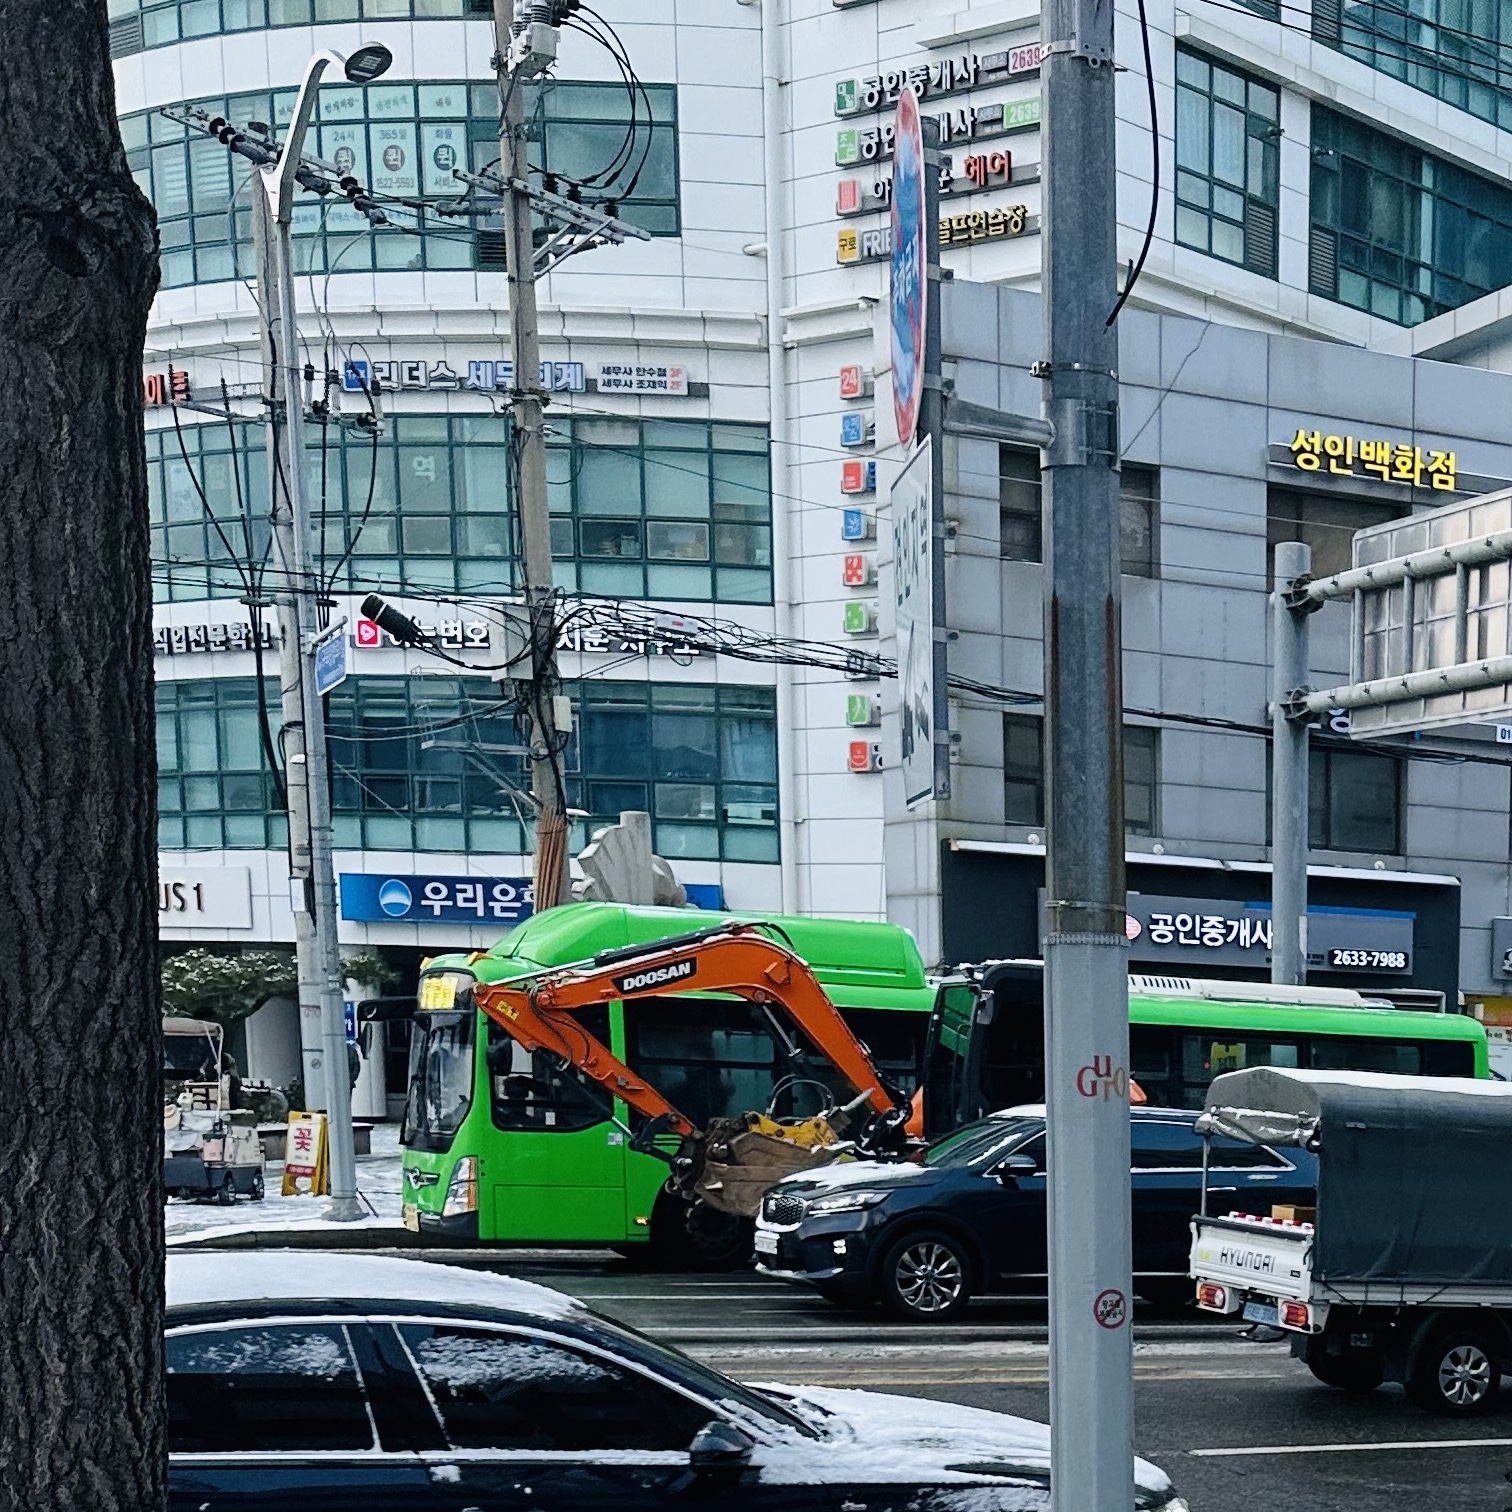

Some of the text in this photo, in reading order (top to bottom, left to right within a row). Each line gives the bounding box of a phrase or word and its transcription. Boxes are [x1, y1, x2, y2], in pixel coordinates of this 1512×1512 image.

[861, 53, 979, 108] 공인중개사
[860, 106, 977, 160] 공인개사
[964, 150, 1011, 187] 헤어
[1150, 913, 1273, 950] 공인중개사
[1333, 949, 1405, 968] 2633-7988
[623, 962, 691, 991] DOOSAN
[295, 1127, 313, 1152] 꽃
[1220, 1246, 1277, 1273] HYUNDAI
